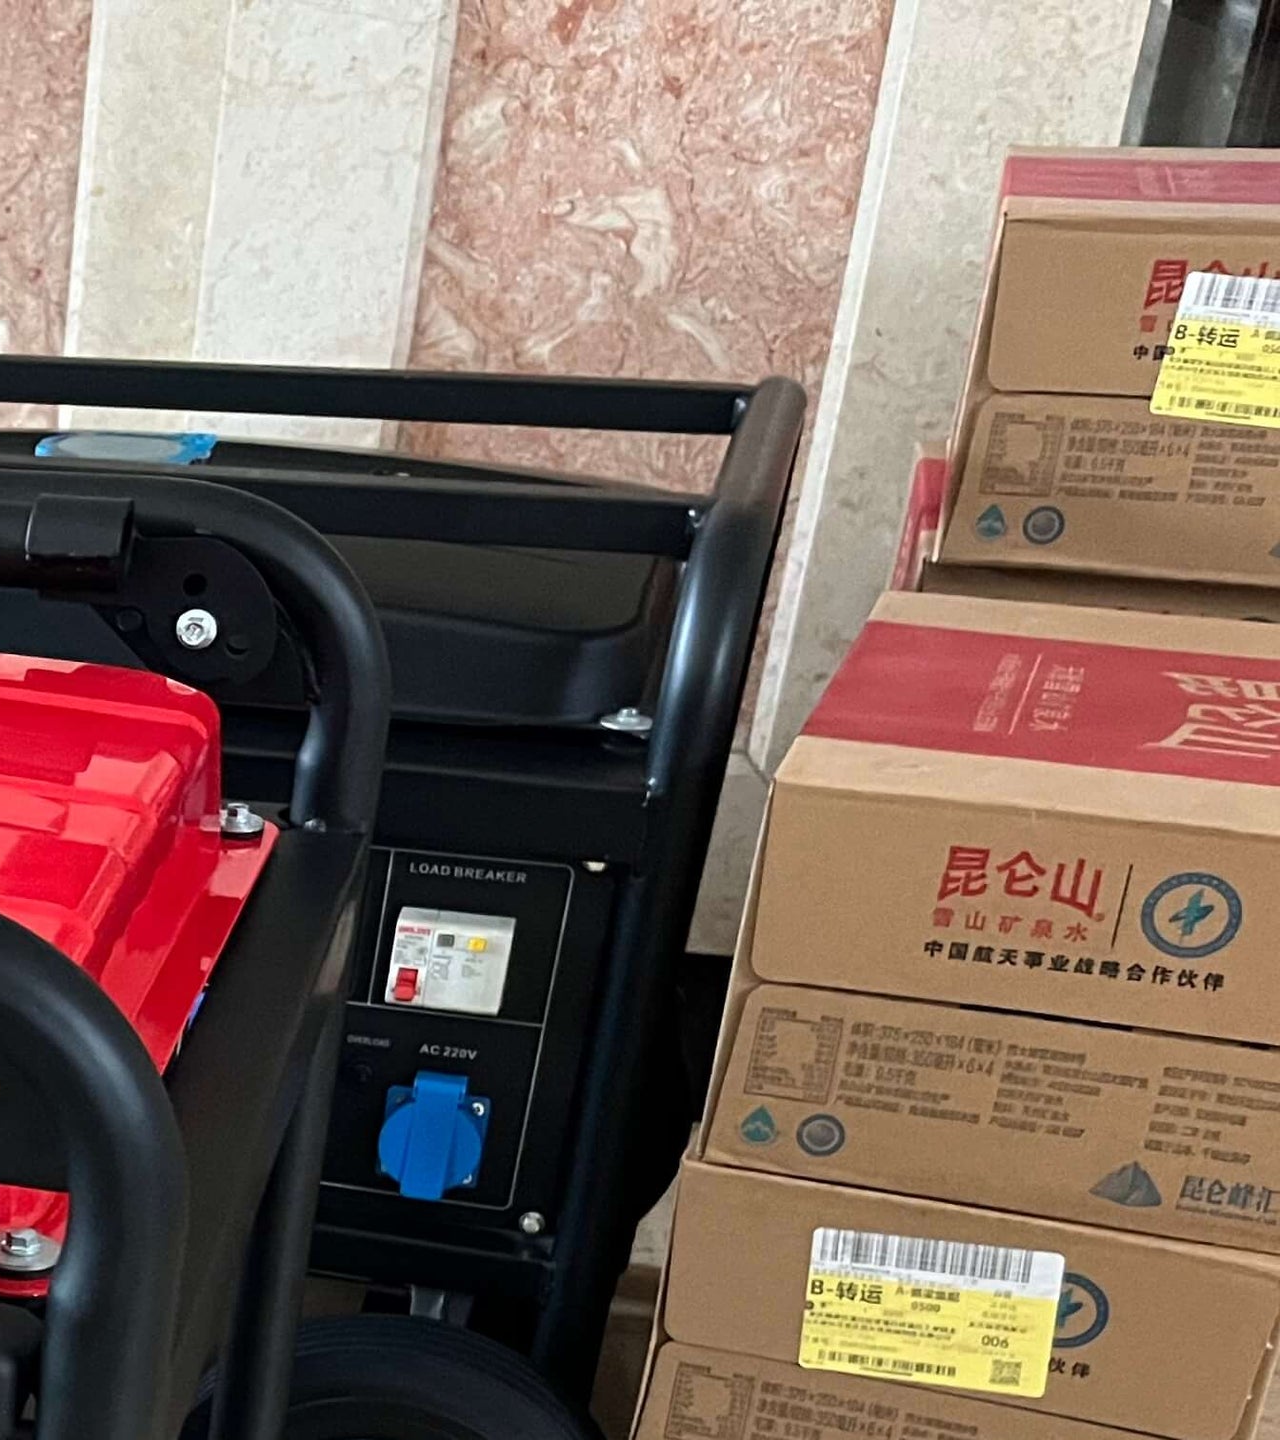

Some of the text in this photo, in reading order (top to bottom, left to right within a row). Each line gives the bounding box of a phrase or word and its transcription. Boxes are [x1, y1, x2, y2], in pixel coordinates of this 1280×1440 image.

[409, 862, 527, 883] LOAD BREAKER
[937, 845, 1102, 922] 昆仑山
[932, 906, 1089, 943] 雪山矿泉水
[923, 940, 1225, 992] 中国航天事业战略合作伙伴
[420, 1043, 478, 1060] AC 220V
[810, 1279, 883, 1305] B-转运
[981, 1334, 1009, 1350] 006
